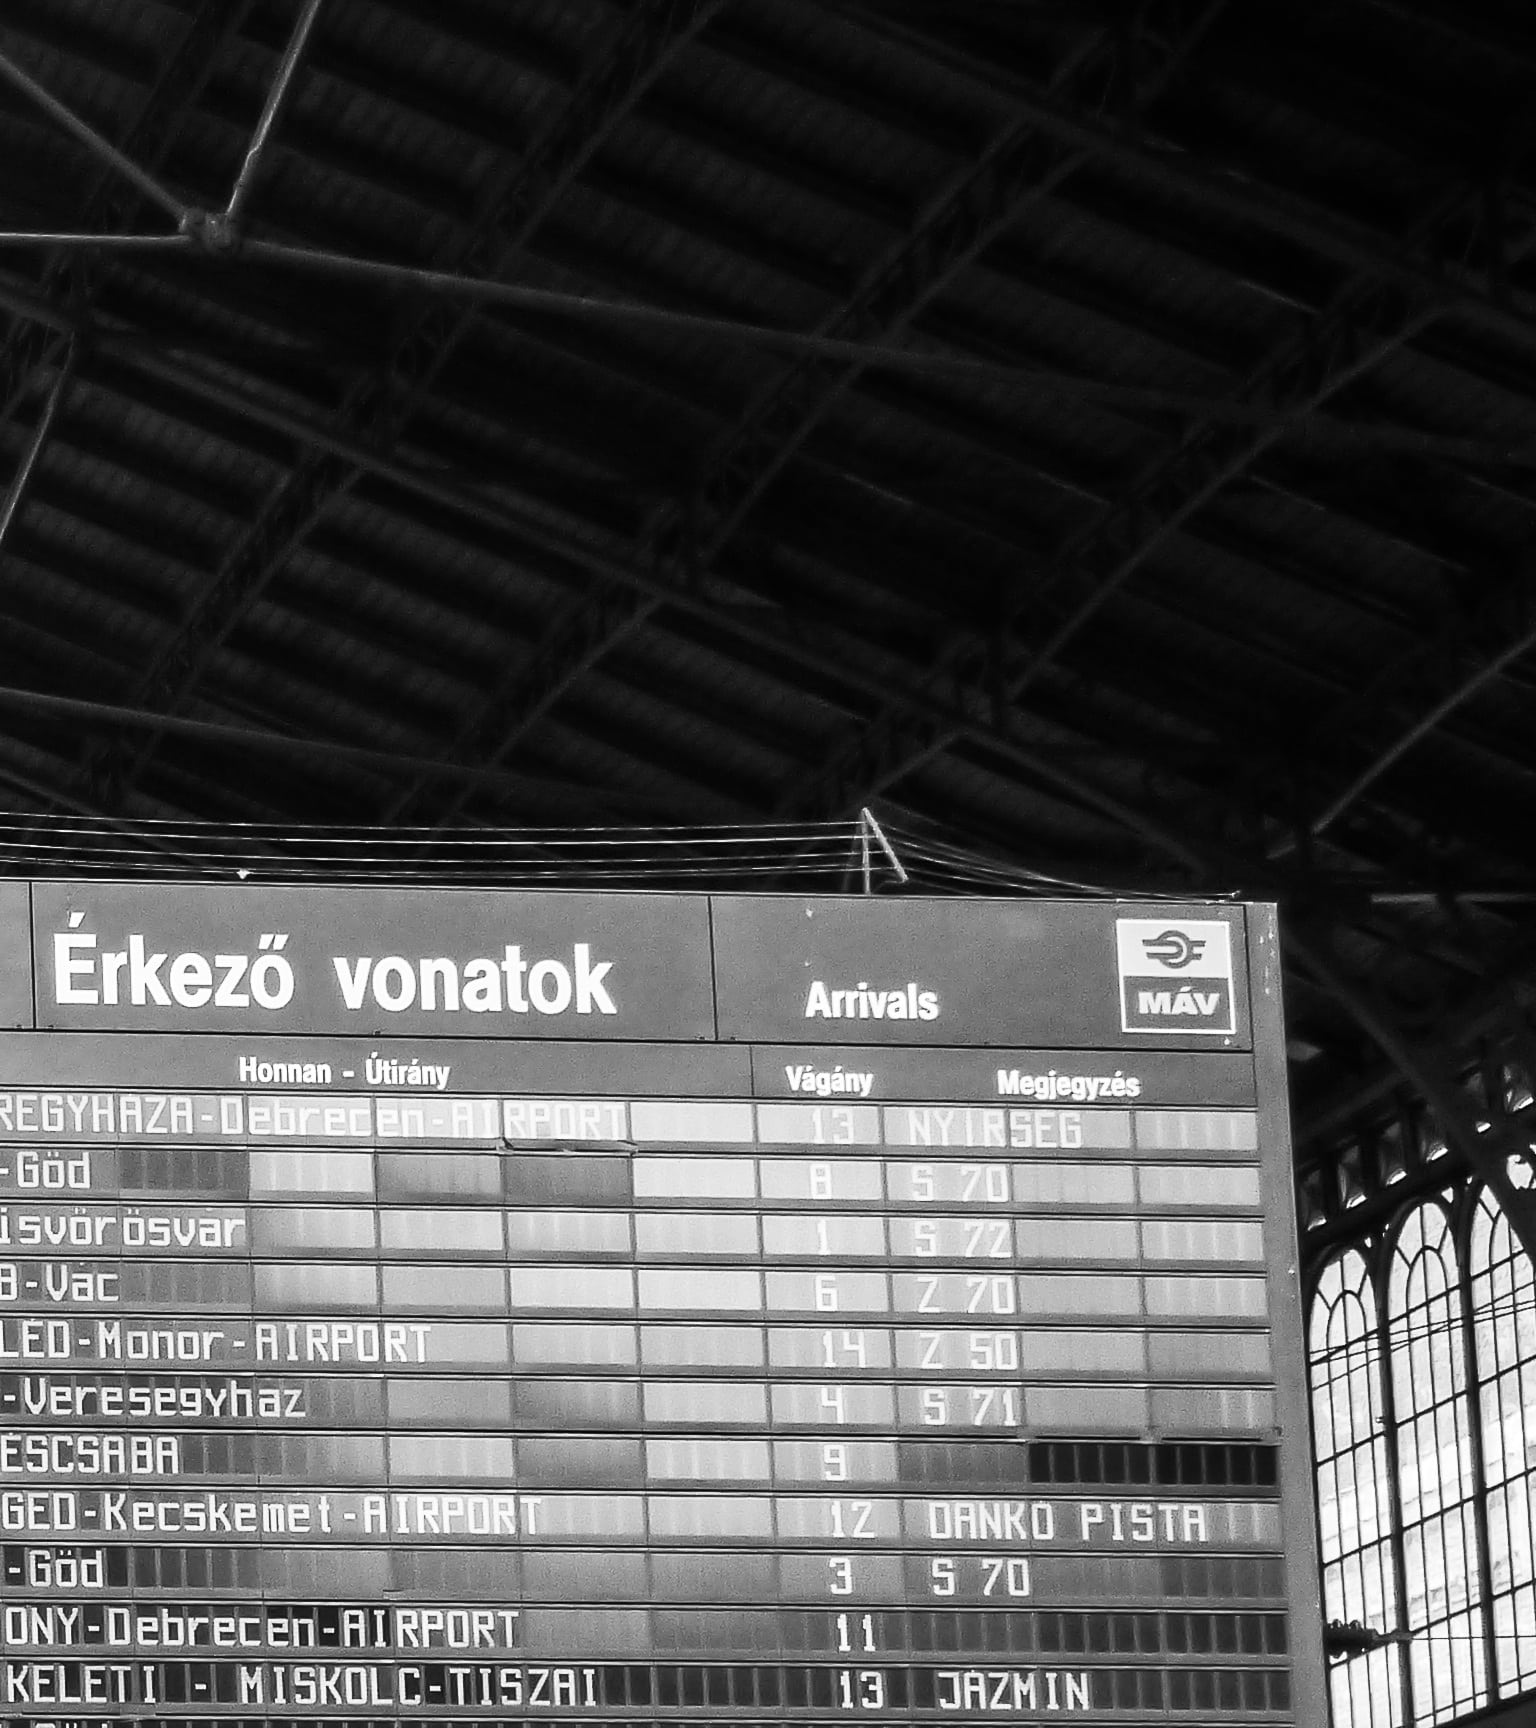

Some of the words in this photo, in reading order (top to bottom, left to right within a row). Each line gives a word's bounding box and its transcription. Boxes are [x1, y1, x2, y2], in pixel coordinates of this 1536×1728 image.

[52, 912, 295, 1009] Érkező
[333, 943, 617, 1016] vonatok
[805, 981, 939, 1021] Arrivals
[1138, 986, 1220, 1016] MÁV
[239, 1056, 332, 1084] Honnan
[365, 1052, 451, 1090] Útirány
[784, 1065, 873, 1098] Vágány
[997, 1069, 1141, 1100] Megjegyzés
[811, 1108, 855, 1144] 13
[960, 1165, 1009, 1202] 70
[963, 1221, 1012, 1257] 72
[966, 1276, 1015, 1313] 70
[823, 1330, 867, 1367] 14
[969, 1332, 1018, 1369] 50
[972, 1388, 1017, 1425] 71
[831, 1499, 876, 1536] 12
[1080, 1501, 1204, 1538] PISTA
[982, 1556, 1031, 1593] 70
[837, 1612, 877, 1649] 11
[242, 1665, 598, 1705] MISKOLC-TISZAI
[840, 1669, 885, 1706] 13
